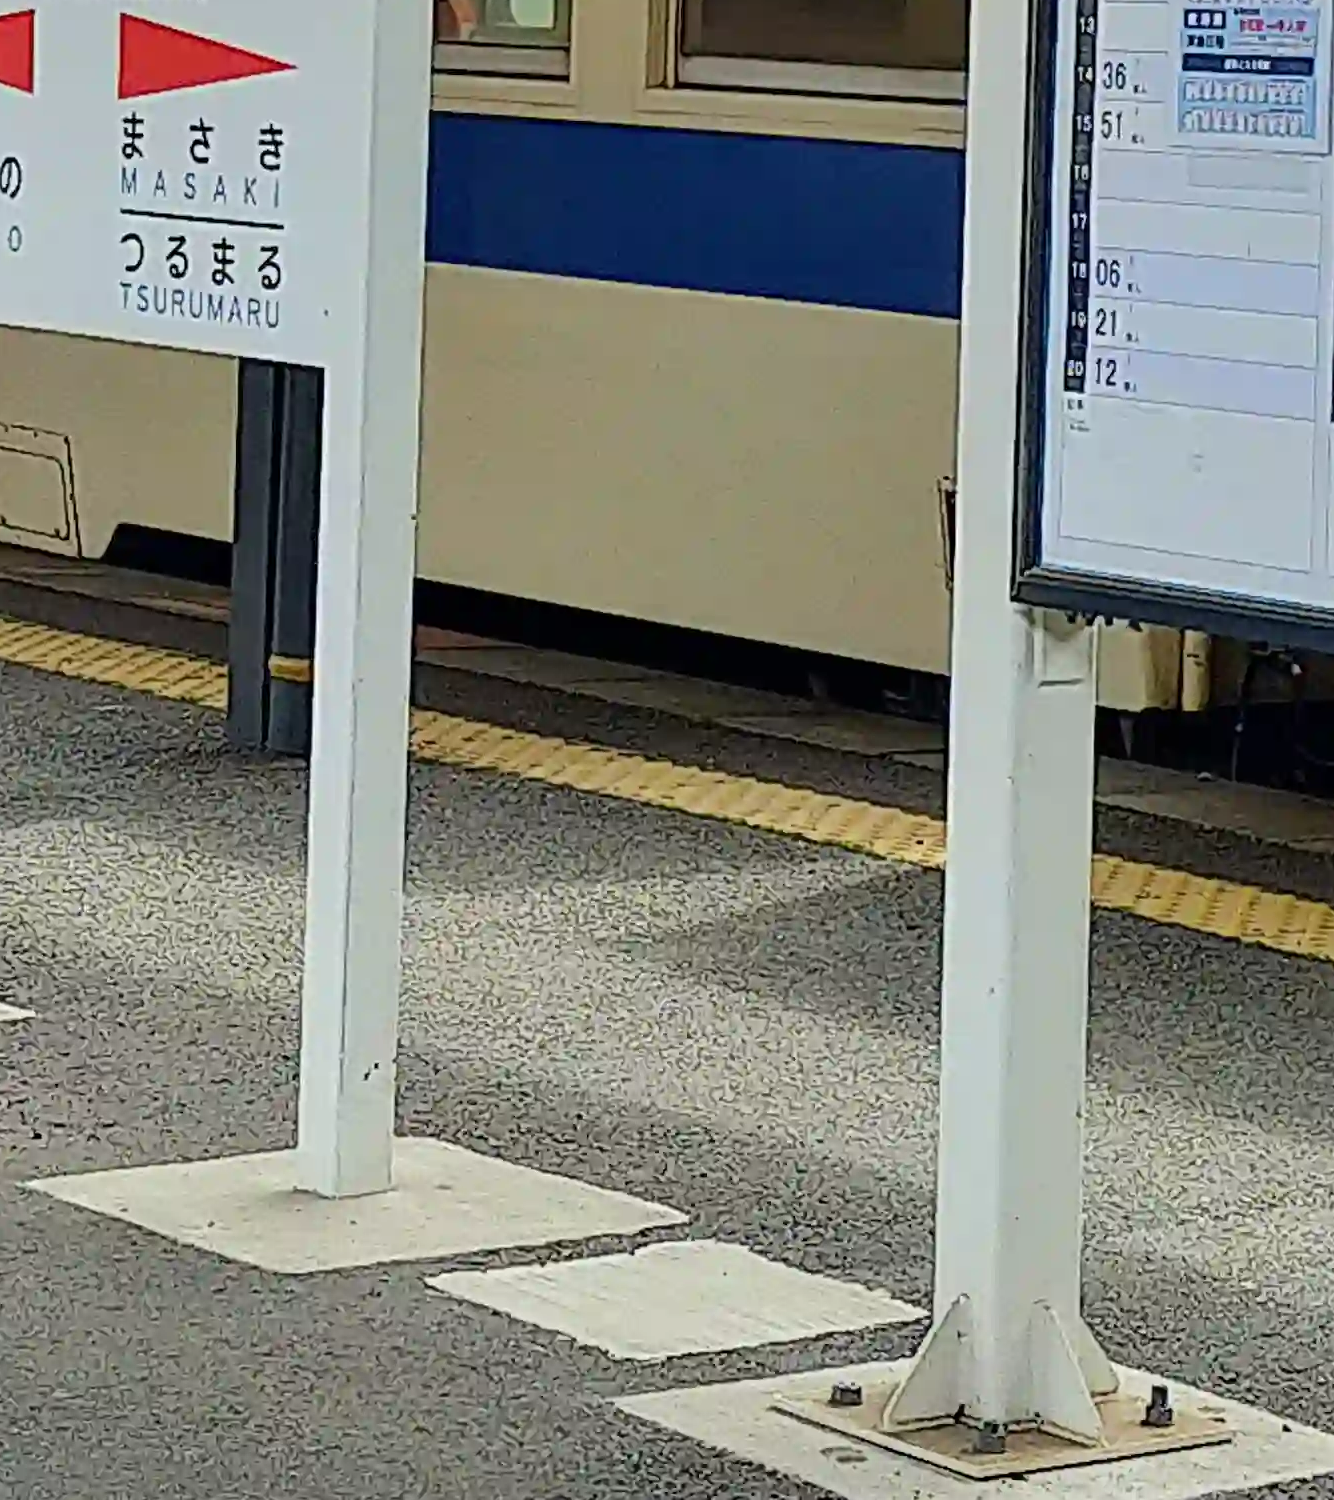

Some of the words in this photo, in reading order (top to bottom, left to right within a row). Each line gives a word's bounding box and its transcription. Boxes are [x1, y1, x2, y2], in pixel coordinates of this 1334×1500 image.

[1103, 62, 1127, 91] 36
[1101, 111, 1123, 139] 51
[121, 112, 285, 172] まさき
[121, 169, 281, 208] MASAKI
[1072, 213, 1087, 229] 17
[121, 234, 283, 291] つるまる
[1095, 260, 1121, 288] 06
[119, 282, 281, 329] TSURUMARU
[1095, 308, 1117, 337] 21
[1095, 358, 1117, 386] 12
